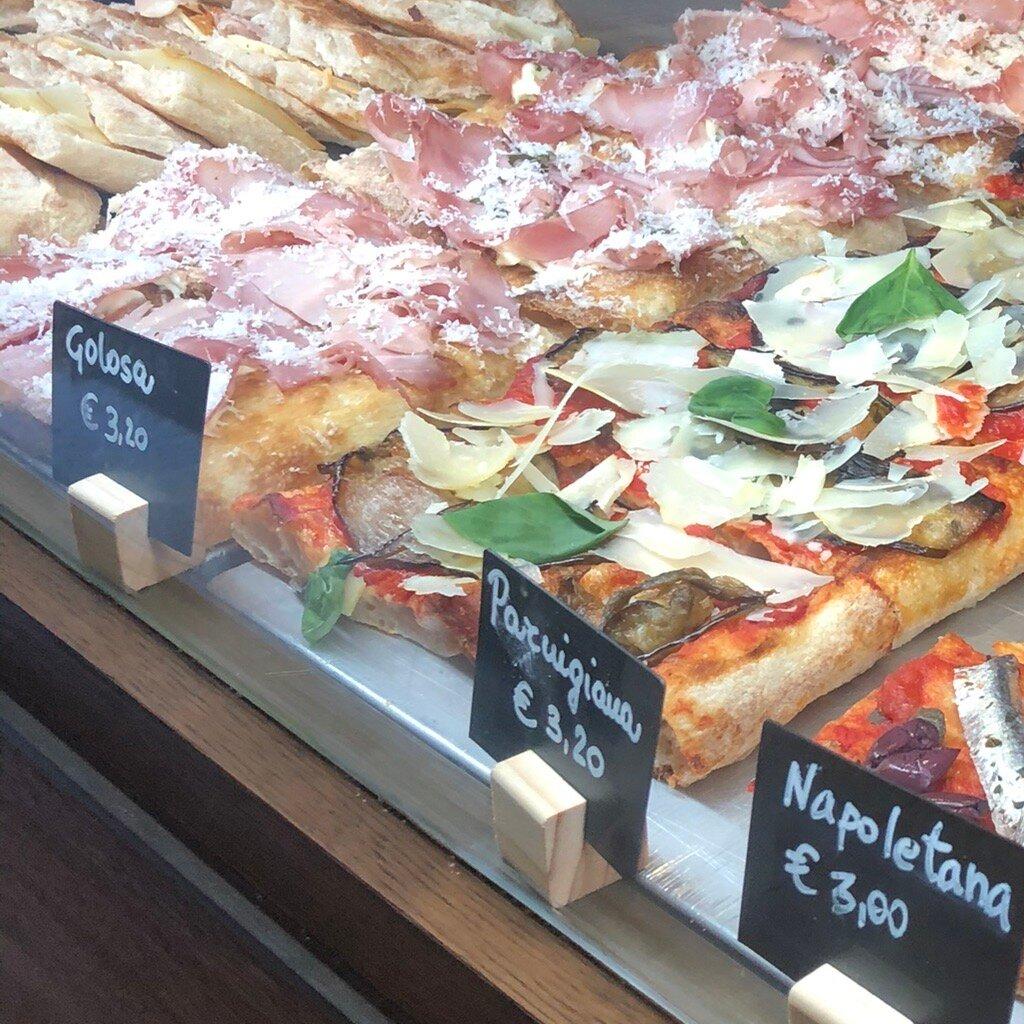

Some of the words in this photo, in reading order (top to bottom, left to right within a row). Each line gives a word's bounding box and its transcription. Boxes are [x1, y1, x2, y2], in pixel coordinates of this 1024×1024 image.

[65, 324, 155, 396] Golosa
[104, 405, 149, 452] 3,20
[487, 568, 643, 744] Parmigiana
[545, 704, 605, 778] 3,20
[782, 760, 1012, 934] Napoletana
[783, 842, 821, 896] €
[830, 871, 910, 939] 3,00
